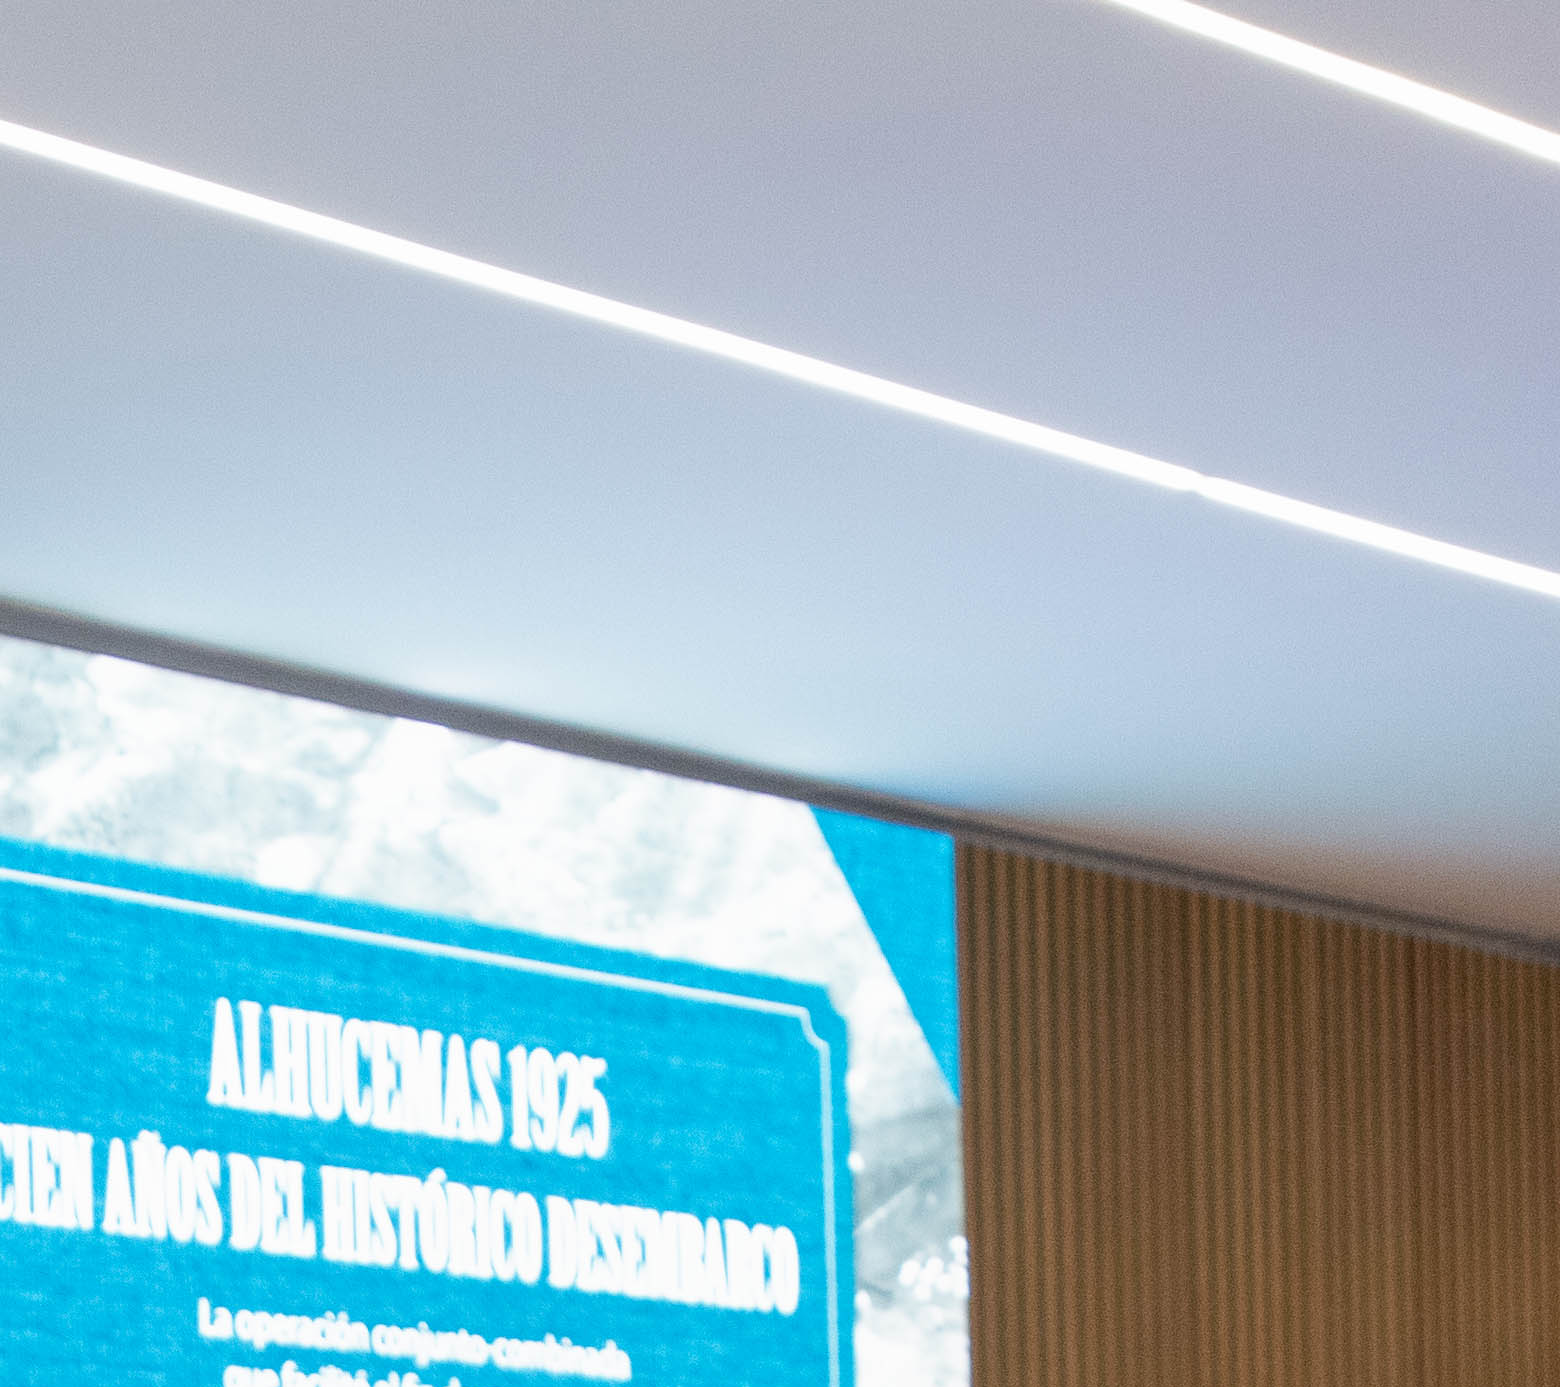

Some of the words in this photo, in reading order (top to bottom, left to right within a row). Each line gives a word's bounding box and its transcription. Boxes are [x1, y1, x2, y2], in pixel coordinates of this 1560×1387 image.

[208, 998, 503, 1144] ALHUCEMAS
[508, 1046, 610, 1158] 1925
[102, 1130, 222, 1245] AÑOS
[227, 1152, 316, 1258] DEL
[320, 1165, 543, 1284] HISTÓRICO
[546, 1195, 800, 1315] DESEMBARCO
[197, 1297, 233, 1339] La
[236, 1310, 370, 1351] operación
